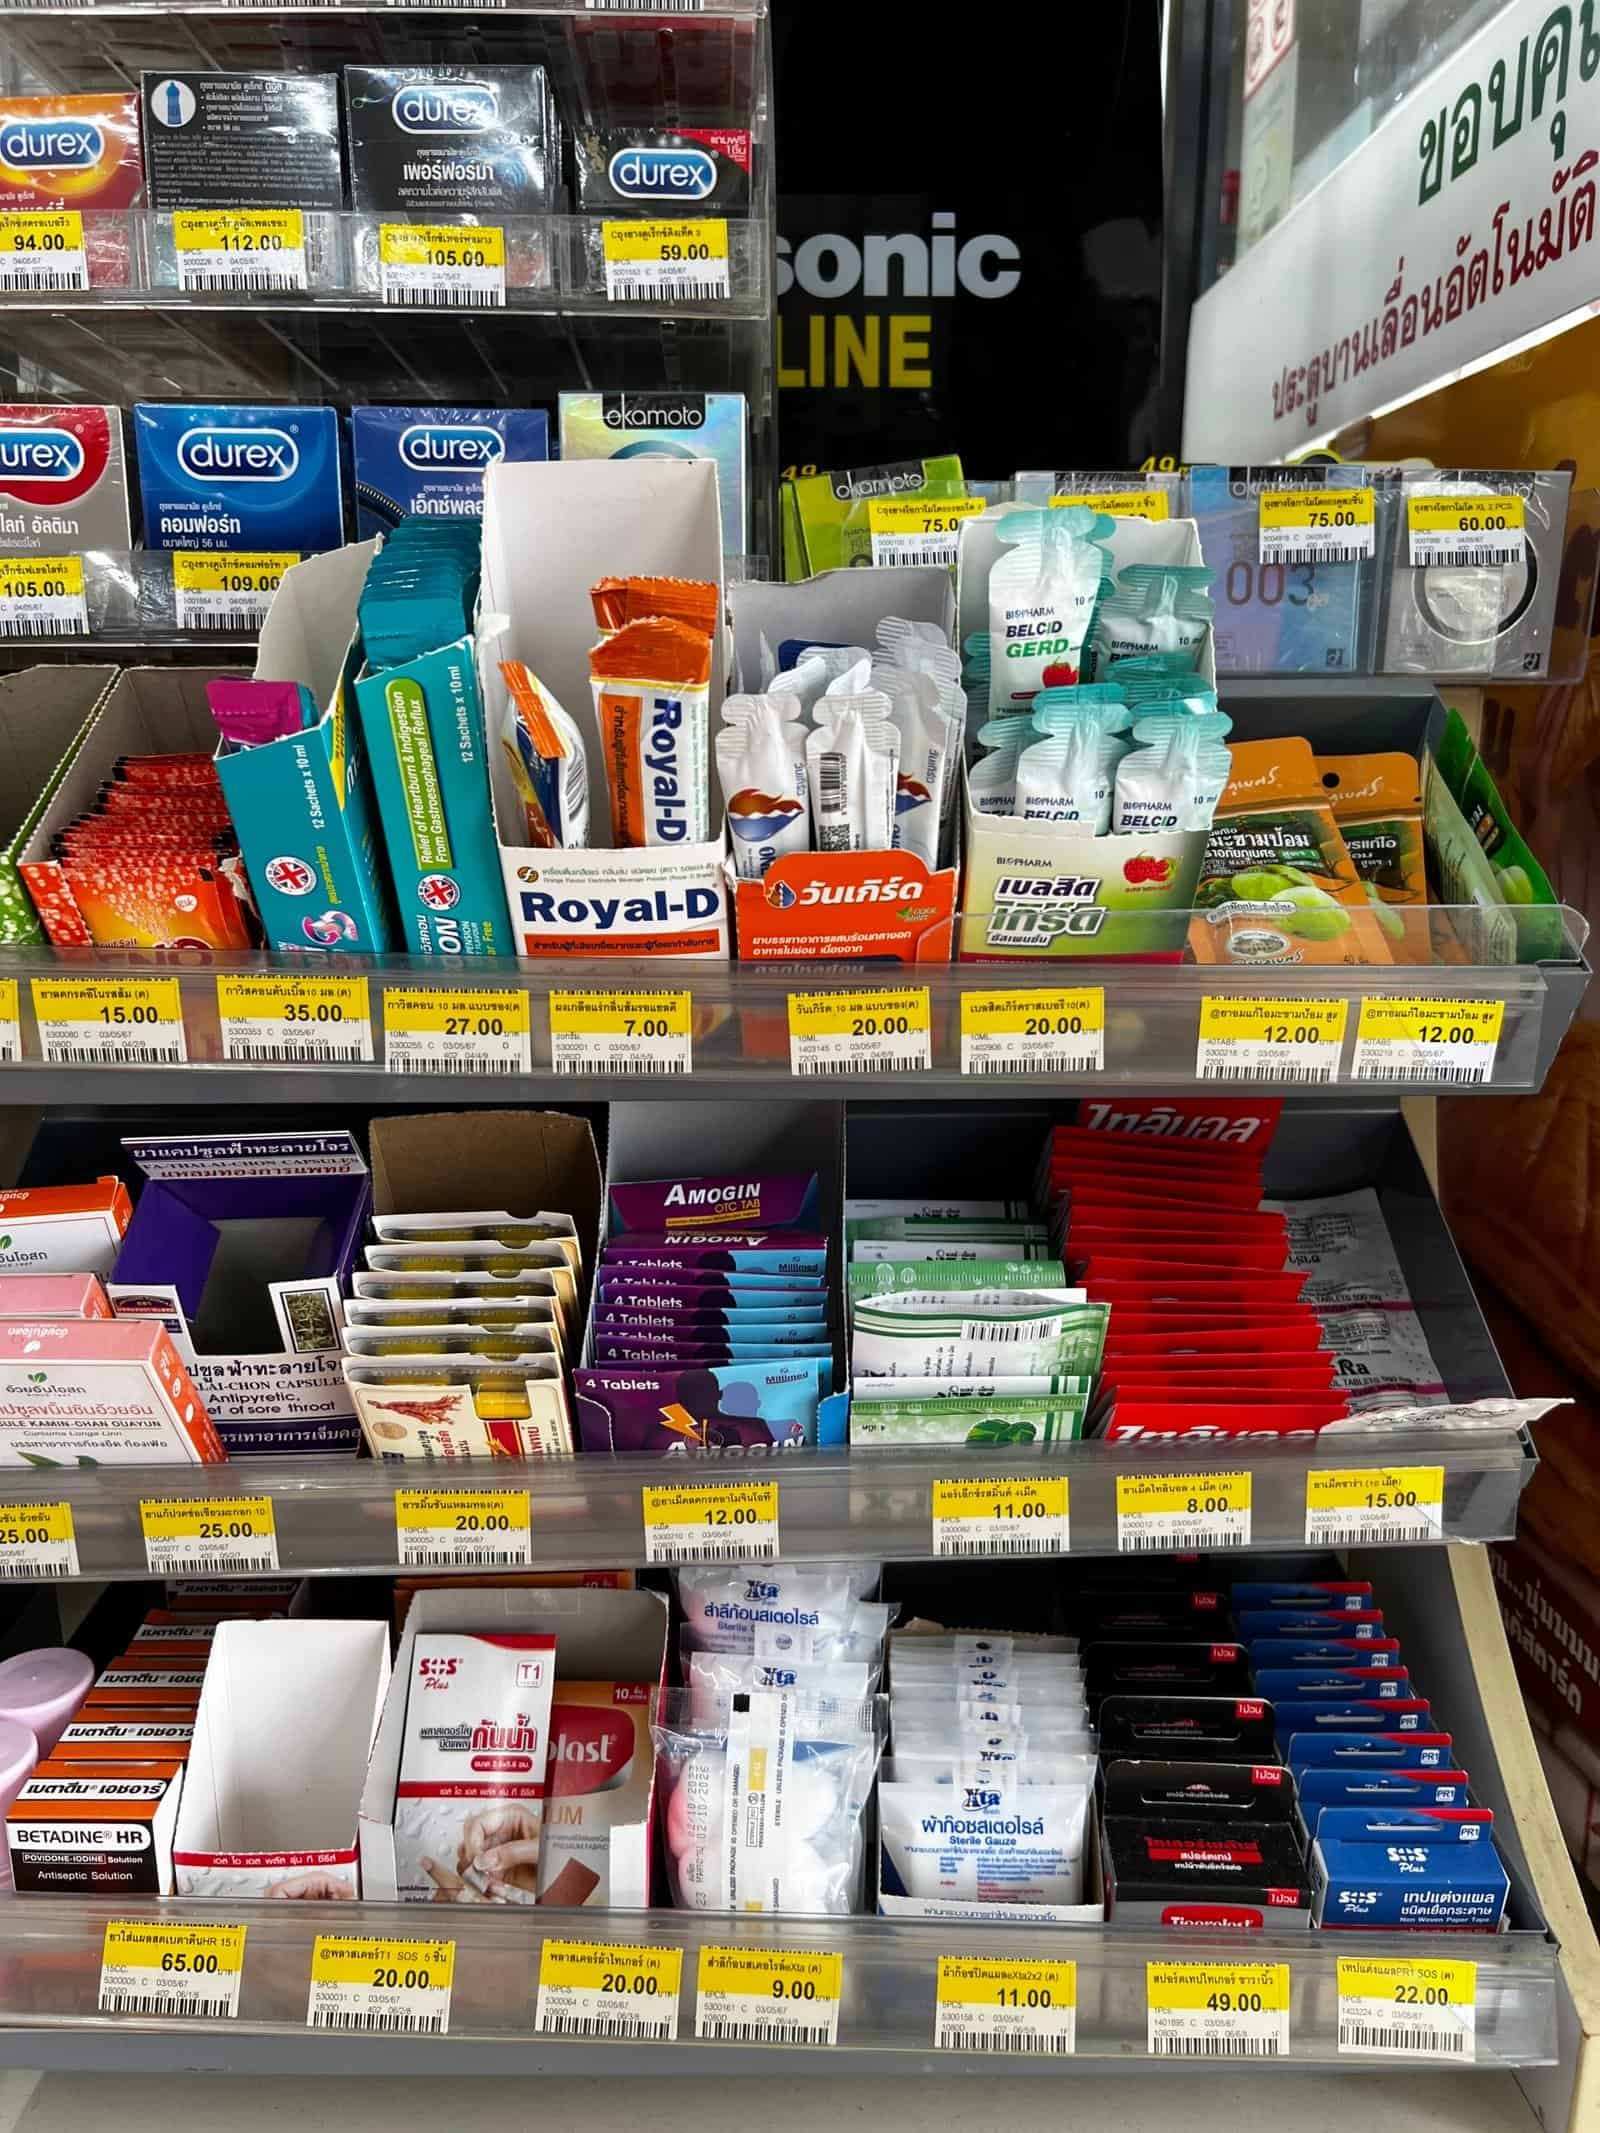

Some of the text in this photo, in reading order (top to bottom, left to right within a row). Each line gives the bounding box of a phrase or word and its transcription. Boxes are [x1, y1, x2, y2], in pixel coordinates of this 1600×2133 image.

[403, 90, 490, 122] durex
[6, 129, 93, 158] durex
[403, 159, 495, 181] เพอร์ฟอร์มา
[620, 156, 708, 186] durex
[14, 234, 65, 251] 94.00
[220, 235, 281, 250] 112.00
[427, 250, 484, 266] 105.00
[661, 244, 709, 260] 59.00
[1272, 150, 1600, 427] ประตูบานเลื่อนอัตโนมัติ
[777, 315, 932, 387] LINE
[607, 403, 703, 427] okamoto
[190, 437, 287, 468] durex
[410, 431, 493, 460] durex
[0, 443, 70, 468] urex
[836, 472, 924, 500] okamoto
[31, 515, 79, 535] อัลติมา
[161, 513, 241, 534] คอมฟอร์ท
[1309, 512, 1355, 527] 75.00
[1459, 517, 1505, 531] 60.00
[201, 538, 213, 548] 56
[4, 581, 65, 597] 105.00
[220, 576, 280, 591] 109.00
[1006, 607, 1055, 619] BIOPHARM
[1006, 620, 1063, 638] BELCID
[1006, 638, 1069, 658] GERD
[1111, 640, 1159, 652] BIOPHARM
[456, 706, 474, 763] 12 Sachets
[391, 691, 435, 864] Relief of Heartburn Indigestion
[645, 698, 687, 842] Royal-D
[409, 699, 448, 864] From Gastroesophageal Reflux
[303, 778, 325, 829] 12 Sachets
[1025, 796, 1074, 807] BIOPHARM
[1123, 801, 1172, 812] BIOPHARM
[1120, 815, 1178, 828] BELCID
[1208, 826, 1310, 849] มะขามป้อม
[996, 856, 1053, 868] BIOPHARM
[799, 875, 923, 906] วันเกิร์ด
[999, 876, 1097, 897] เบลสิด
[519, 888, 720, 930] Royal-D
[100, 1006, 158, 1024] 15.00
[284, 1004, 343, 1022] 35.00
[445, 1018, 503, 1036] 27.00
[624, 1020, 669, 1037] 7.00
[852, 1017, 908, 1036] 20.00
[1025, 1017, 1082, 1036] 20.00
[1263, 1026, 1320, 1044] 12.00
[1418, 1026, 1475, 1045] 12.00
[133, 1139, 349, 1158] ยาแคปซูลฟ้าทะลายโจร
[664, 1182, 761, 1207] AMOGIN
[714, 1199, 761, 1214] OTC TAB
[614, 1295, 683, 1309] 4 Tablets
[605, 1312, 675, 1328] 4 Tablets
[607, 1347, 678, 1361] 4 Tablets
[586, 1377, 661, 1391] 4 Tablets
[229, 1405, 244, 1415] of
[288, 1400, 336, 1412] throat
[29, 1420, 108, 1428] KAMIN-CHAN
[1187, 1497, 1228, 1513] 8.00
[1365, 1491, 1417, 1508] 15.00
[704, 1508, 757, 1525] 12.00
[993, 1502, 1046, 1519] 11.00
[199, 1522, 252, 1539] 25.00
[456, 1515, 509, 1531] 20.00
[704, 1602, 820, 1626] สำลีก้อนสเตอไรล์
[419, 1659, 458, 1676] SOS
[521, 1664, 541, 1681] T1
[423, 1677, 450, 1691] Plus
[614, 1687, 629, 1699] 10
[67, 1726, 127, 1739] เบตาดีน
[472, 1713, 537, 1750] กันน้ำ
[1422, 1751, 1440, 1763] PR1
[26, 1780, 163, 1795] เบตาดีน เอชอาร์
[1437, 1789, 1456, 1802] PR1
[921, 1813, 1045, 1836] ผ้าก๊อซสเตอไรล์
[17, 1830, 144, 1845] BETADINE HR
[949, 1836, 1017, 1847] Sterile Gauze
[1460, 1827, 1480, 1840] PR1
[25, 1854, 143, 1864] POVIDONE-IODINE Solution
[1386, 1847, 1427, 1862] SOS
[37, 1870, 133, 1882] Antiseptic Solution
[1399, 1863, 1425, 1873] Plus
[1338, 1890, 1377, 1904] SOS
[1403, 1890, 1495, 1904] เทปแต่งแผล
[1343, 1904, 1369, 1913] Plus
[1401, 1904, 1493, 1916] ชนิดเยื่อกระดาษ
[161, 1953, 218, 1974] 65.00
[397, 1952, 419, 1962] SOS
[372, 1968, 430, 1989] 20.00
[1417, 1968, 1438, 1980] SOS
[602, 1973, 658, 1995] 20.00
[772, 1980, 816, 2000] 9.00
[996, 1987, 1051, 2009] 11.00
[1207, 1992, 1262, 2013] 49.00
[1394, 1985, 1449, 2006] 22.00
